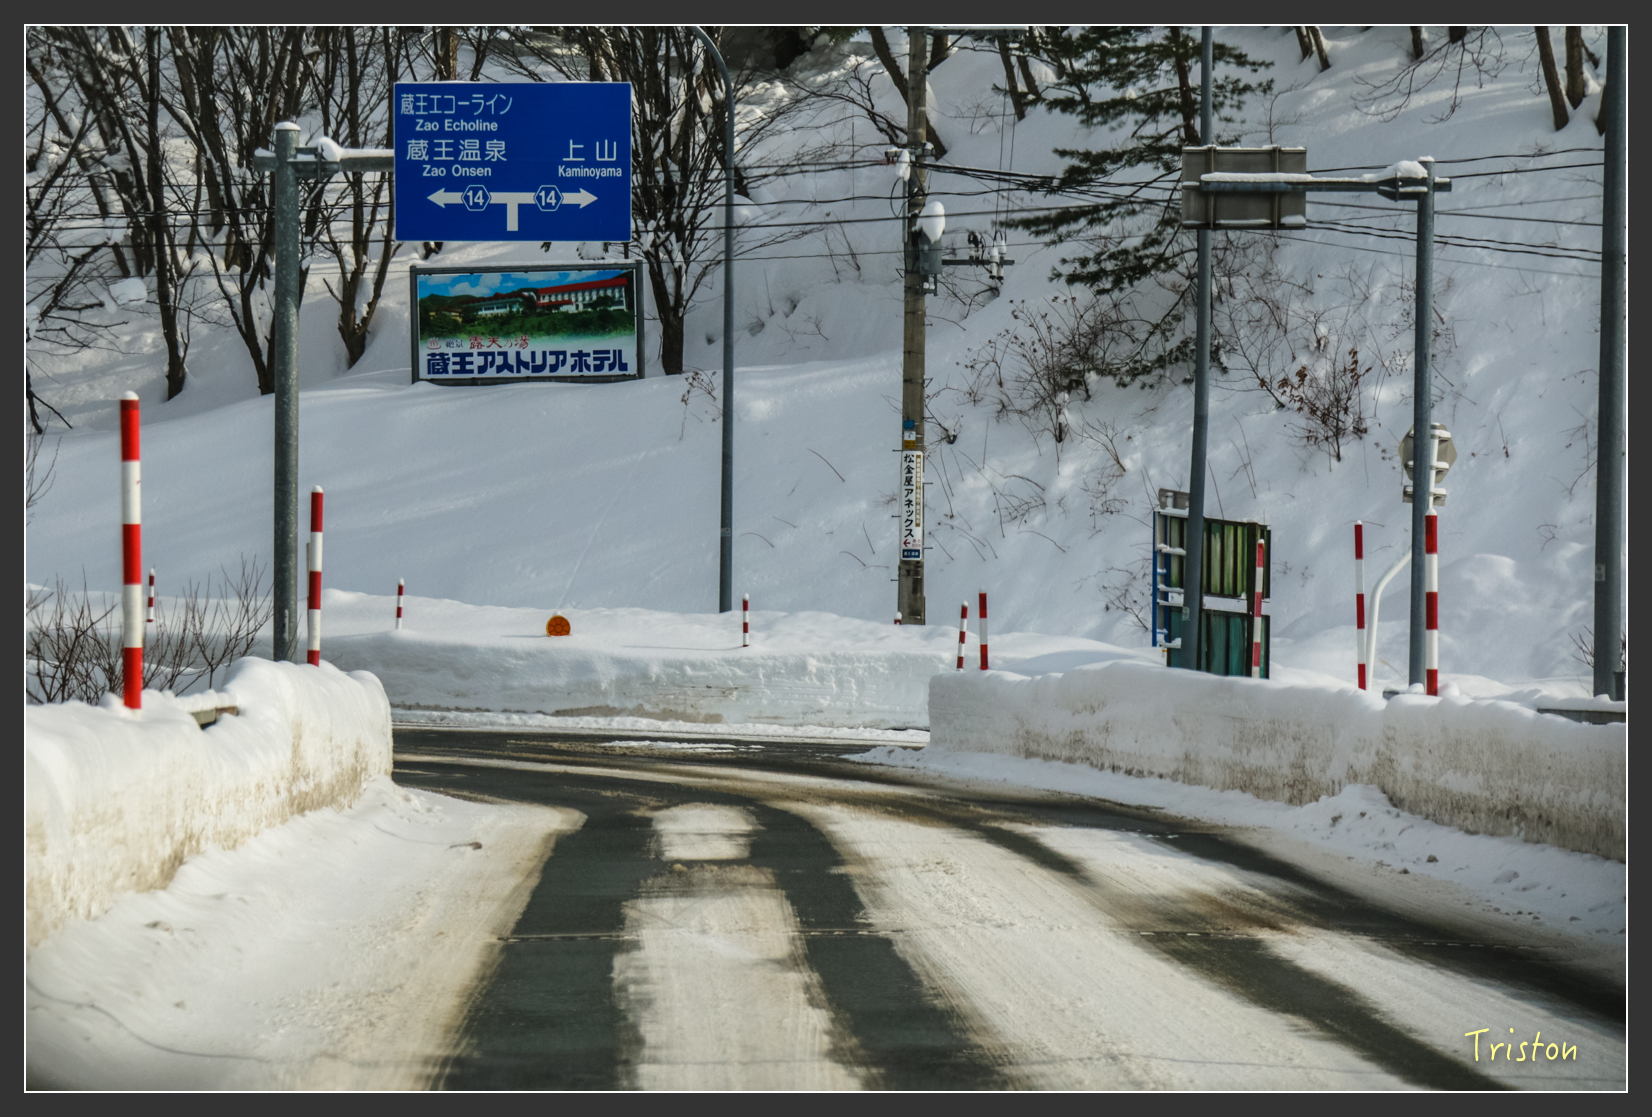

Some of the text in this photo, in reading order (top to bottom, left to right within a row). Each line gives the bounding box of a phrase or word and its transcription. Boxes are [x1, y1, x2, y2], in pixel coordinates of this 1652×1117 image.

[400, 93, 513, 115] 蔵王エコーライン
[415, 119, 498, 132] Zao Echoline
[406, 139, 507, 162] 蔵王温泉
[422, 165, 492, 177] Zao Onsen
[558, 165, 622, 179] Kaminoyama
[466, 190, 485, 206] 14
[538, 190, 557, 206] 14
[426, 349, 629, 375] 蔵王アストリアホテル
[904, 453, 915, 538] 松金屋アネックス
